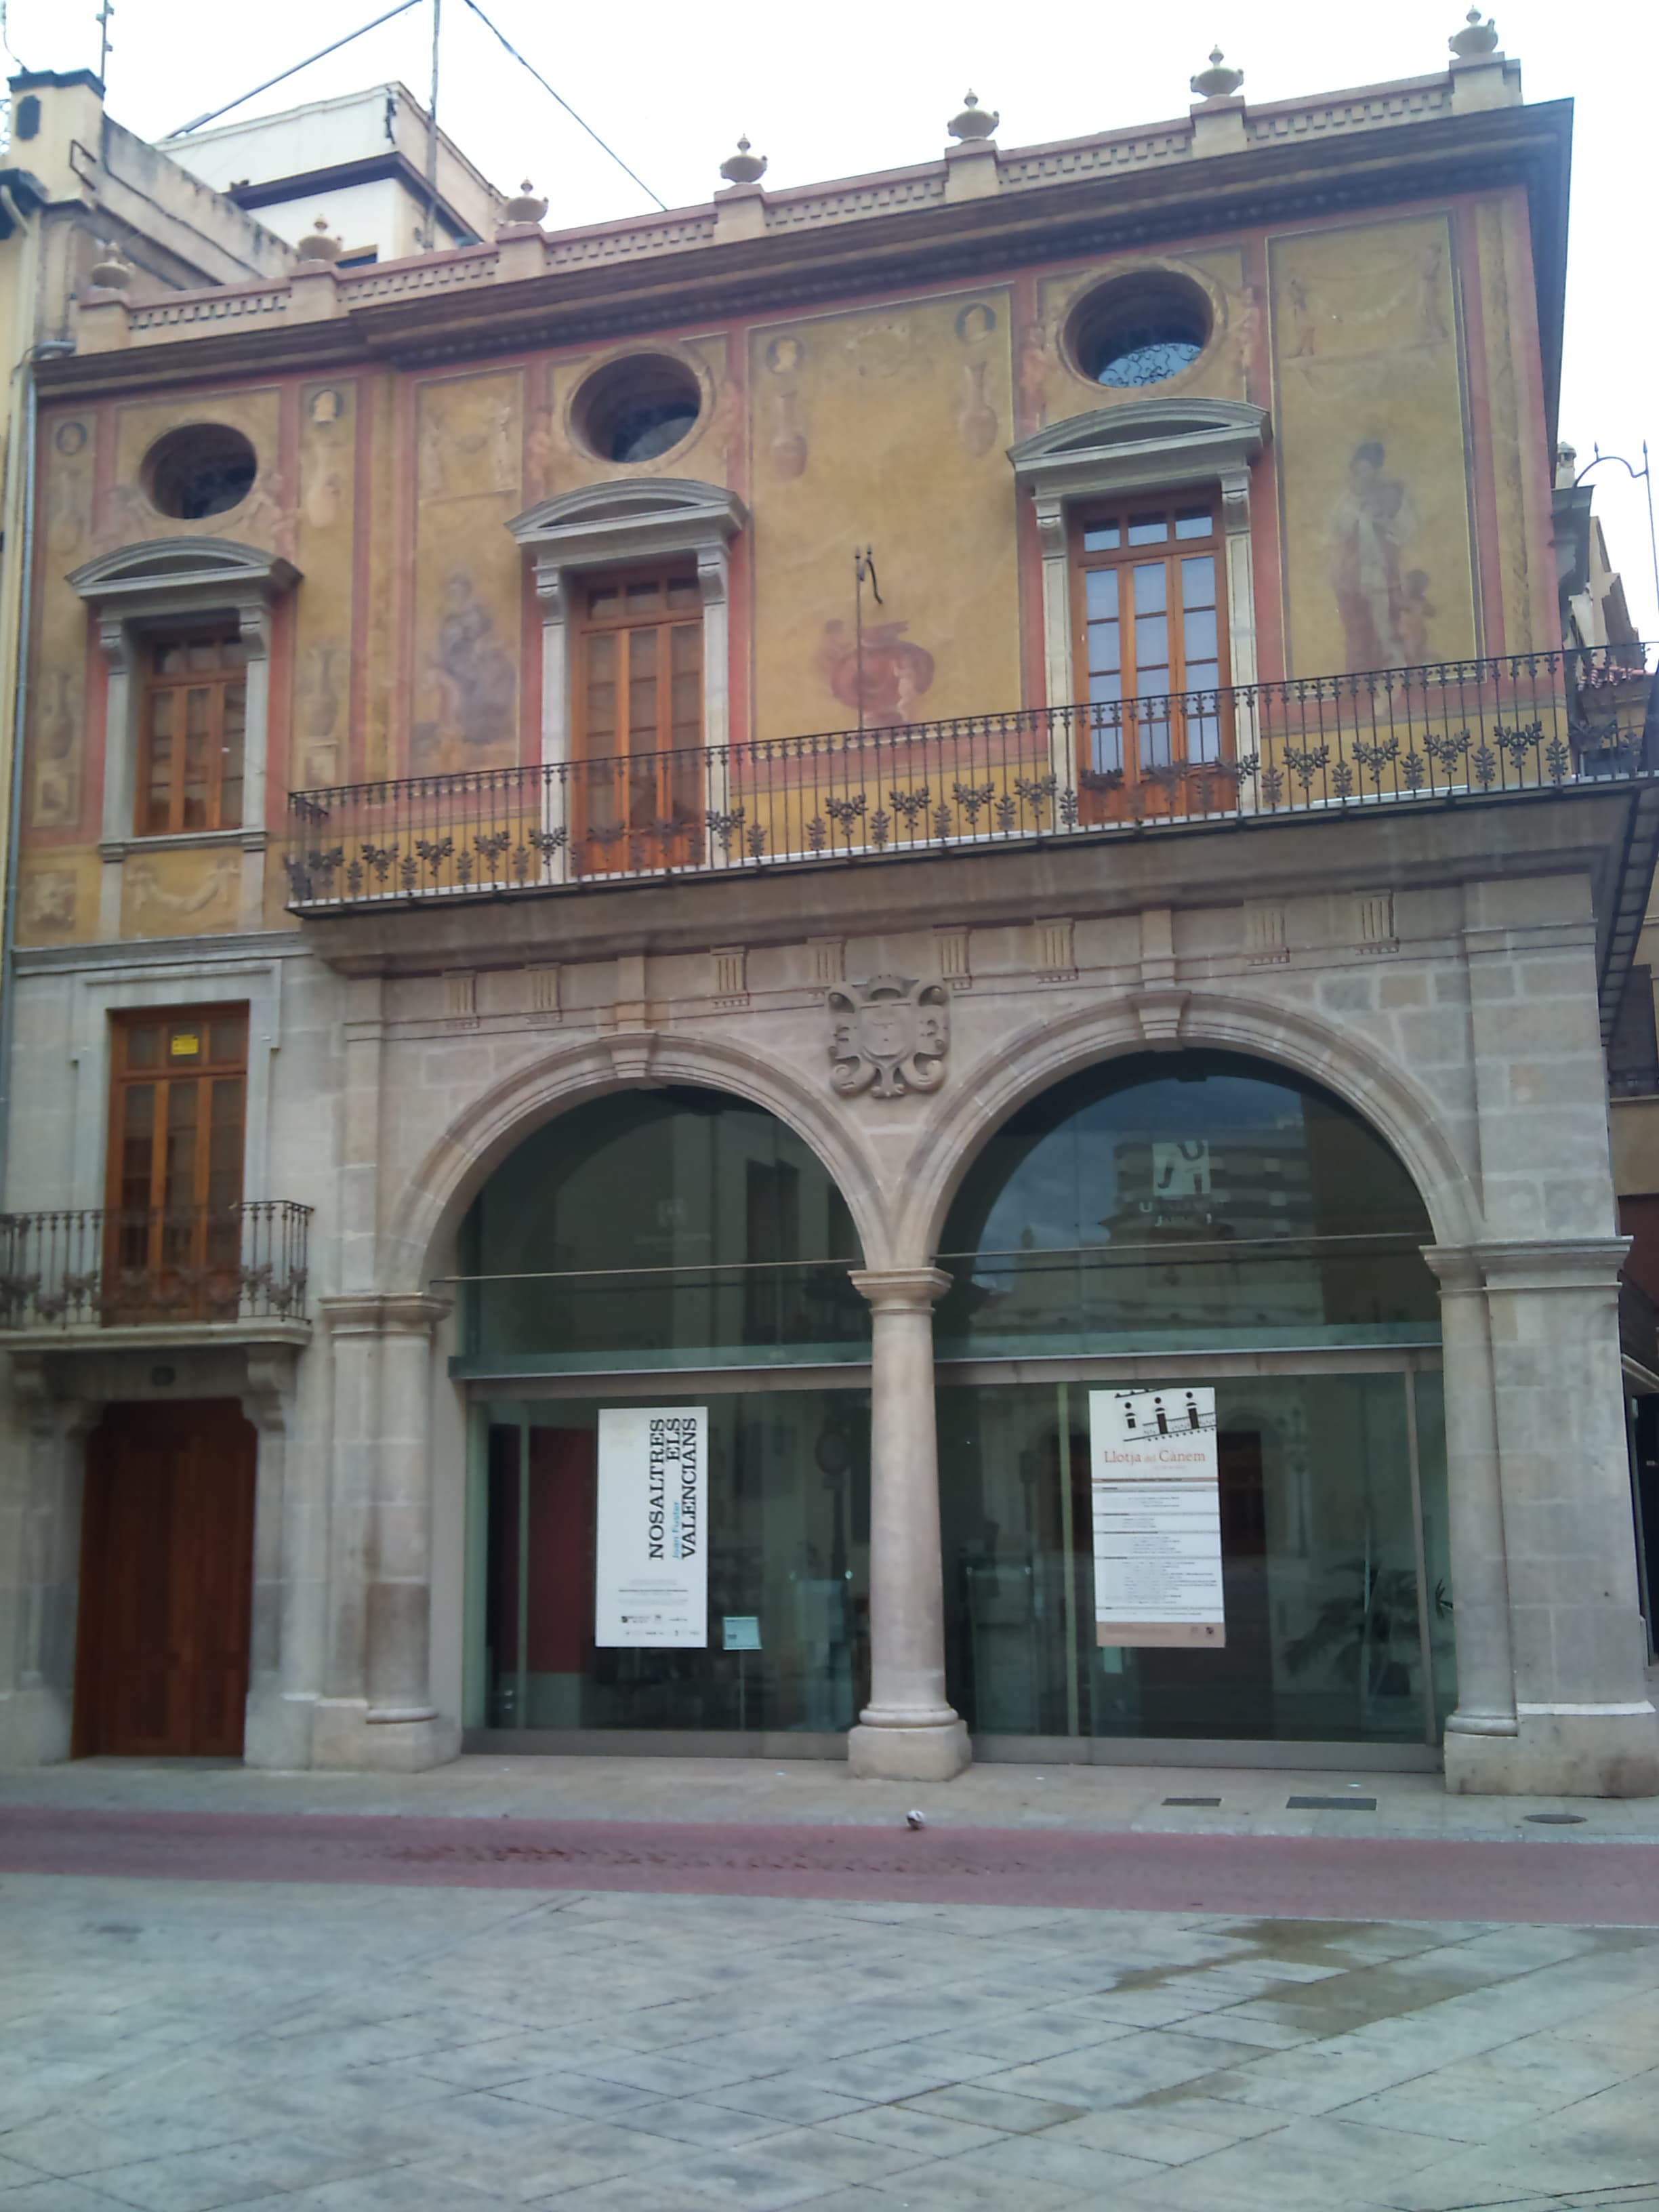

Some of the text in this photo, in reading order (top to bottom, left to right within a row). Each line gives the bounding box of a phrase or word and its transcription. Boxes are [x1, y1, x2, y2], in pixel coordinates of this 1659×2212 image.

[666, 1418, 680, 1461] ELS
[1104, 1450, 1141, 1465] Llotja
[649, 1419, 665, 1560] NOSALTRES
[681, 1418, 697, 1559] VALENCIANS
